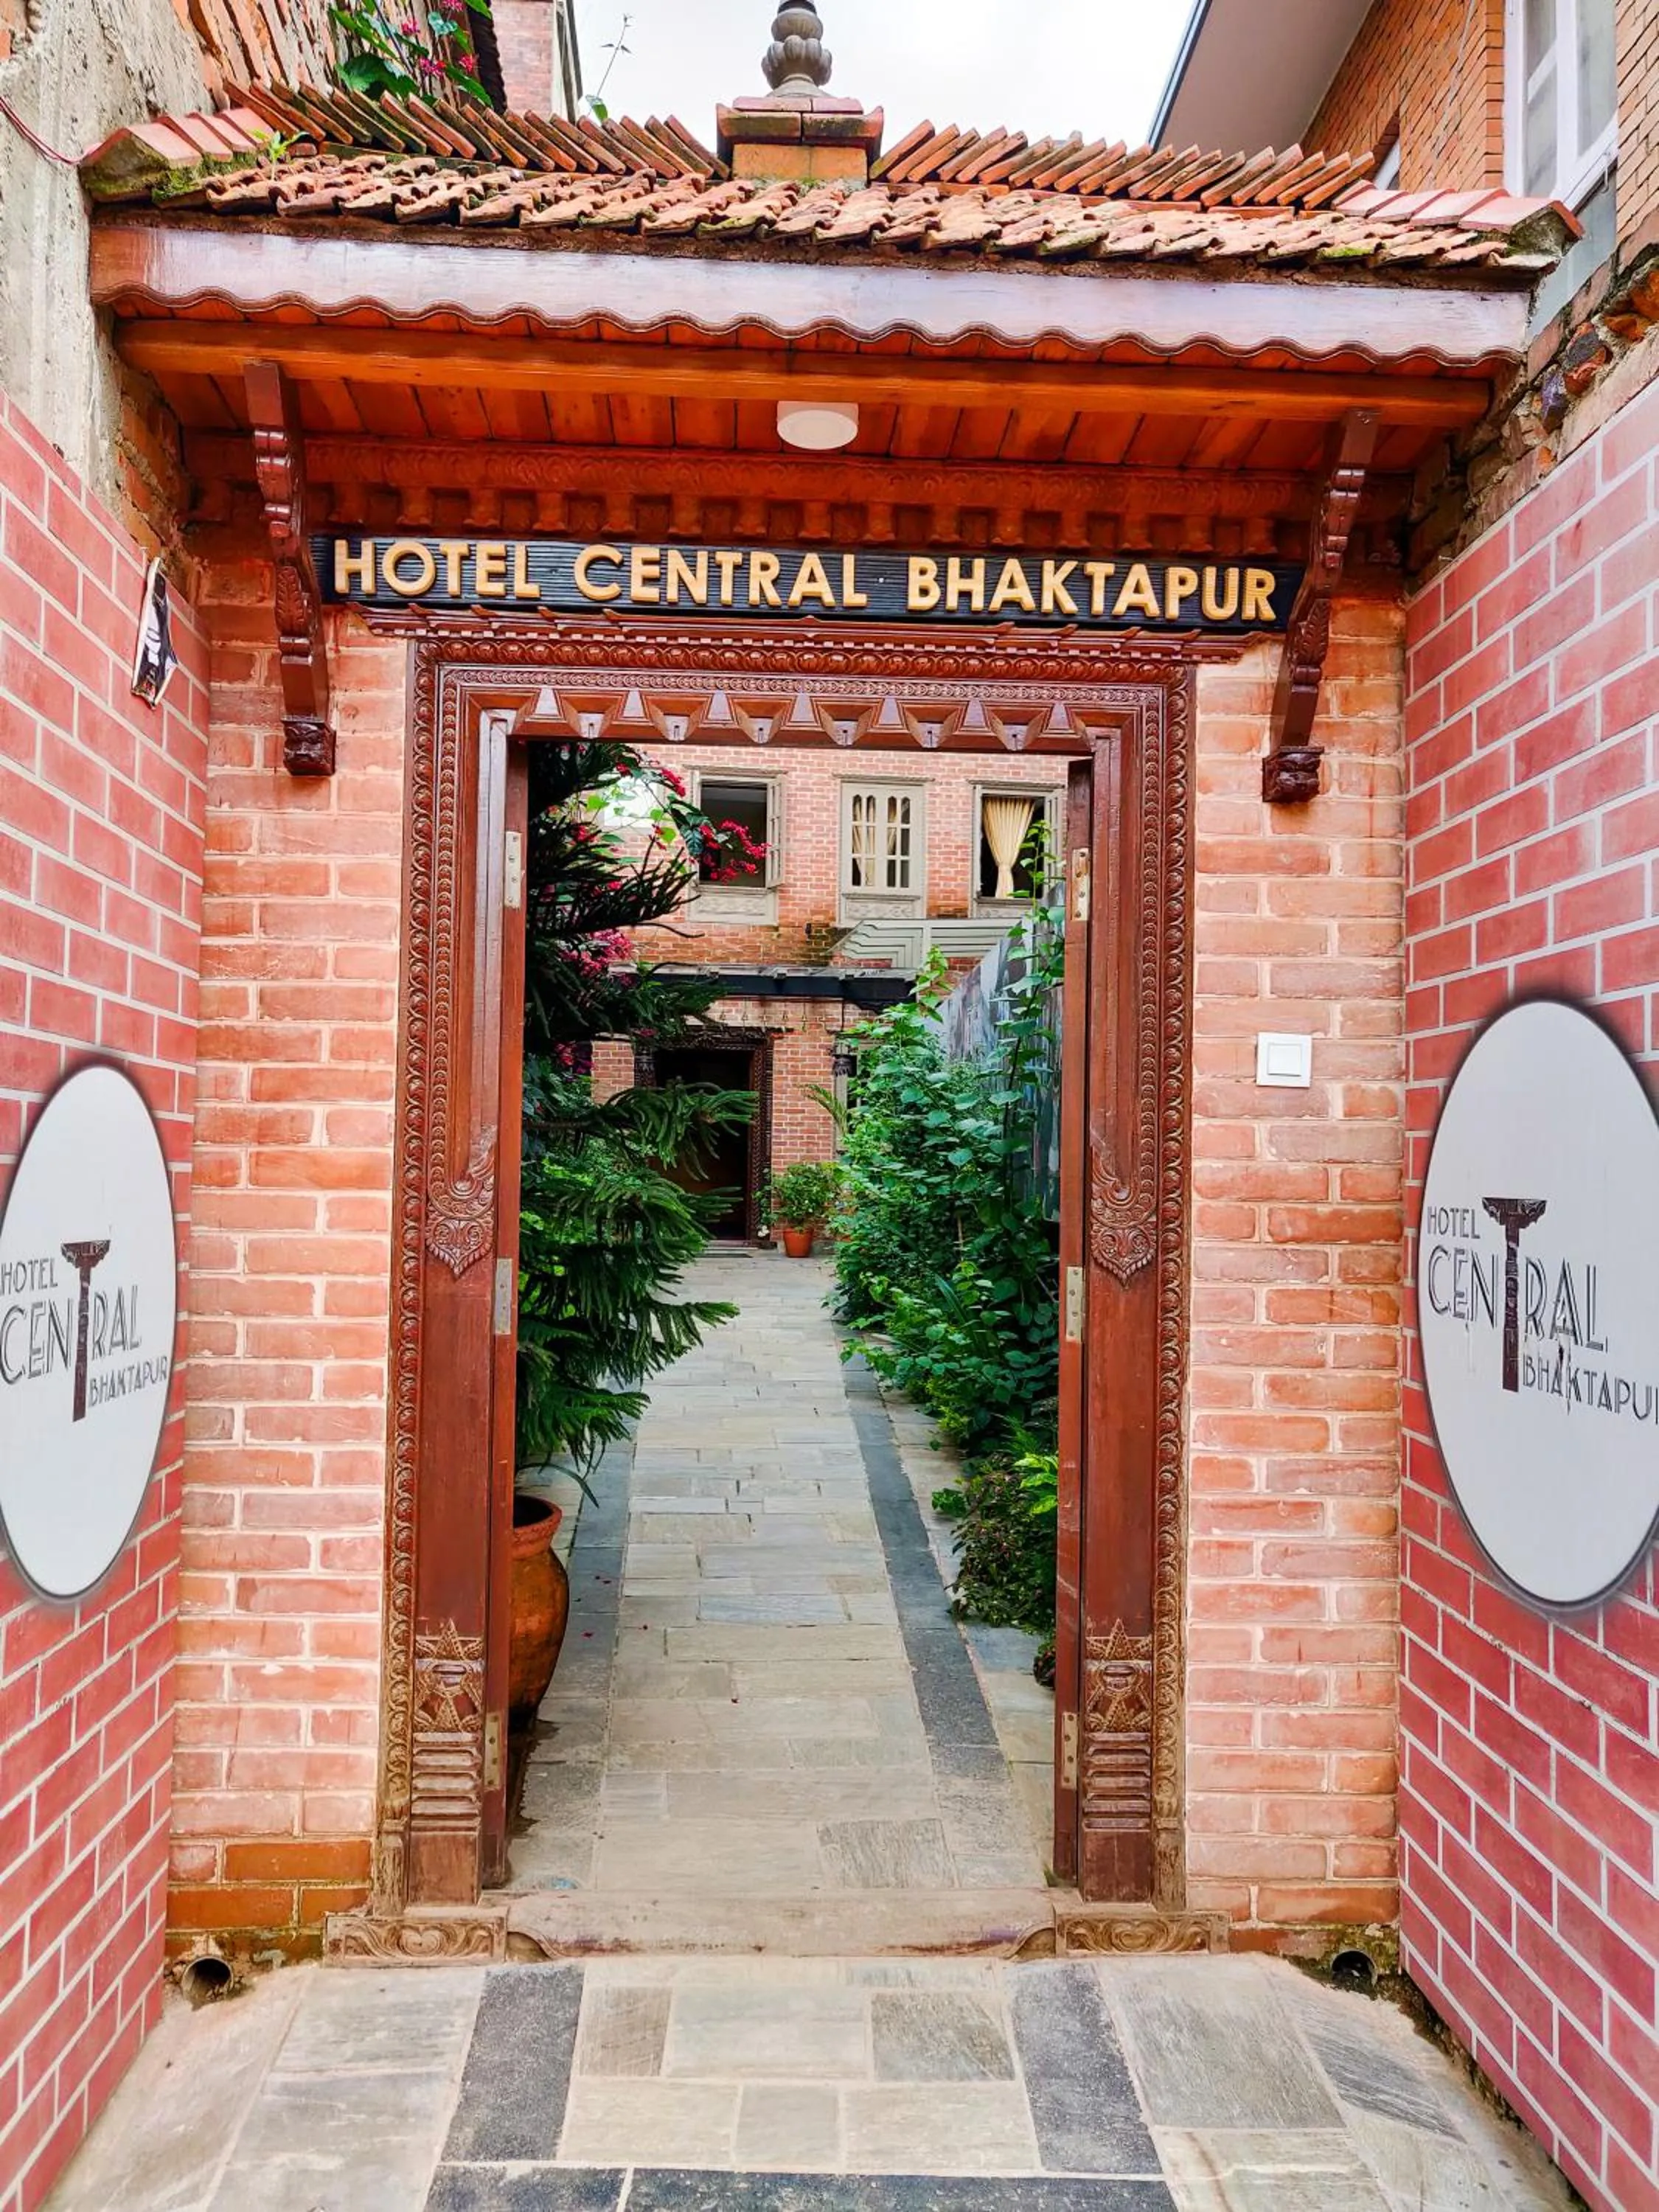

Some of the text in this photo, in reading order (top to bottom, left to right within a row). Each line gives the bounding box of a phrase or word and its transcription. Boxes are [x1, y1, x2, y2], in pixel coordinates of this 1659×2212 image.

[334, 539, 1276, 620] HOTEL CENTRAL BHAKTAPUR
[1427, 1206, 1481, 1239] HOTEL
[1, 1258, 58, 1295] HOTEL
[88, 1356, 168, 1408] BHAKTAPUR
[1523, 1355, 1659, 1425] BHAKTAPU
